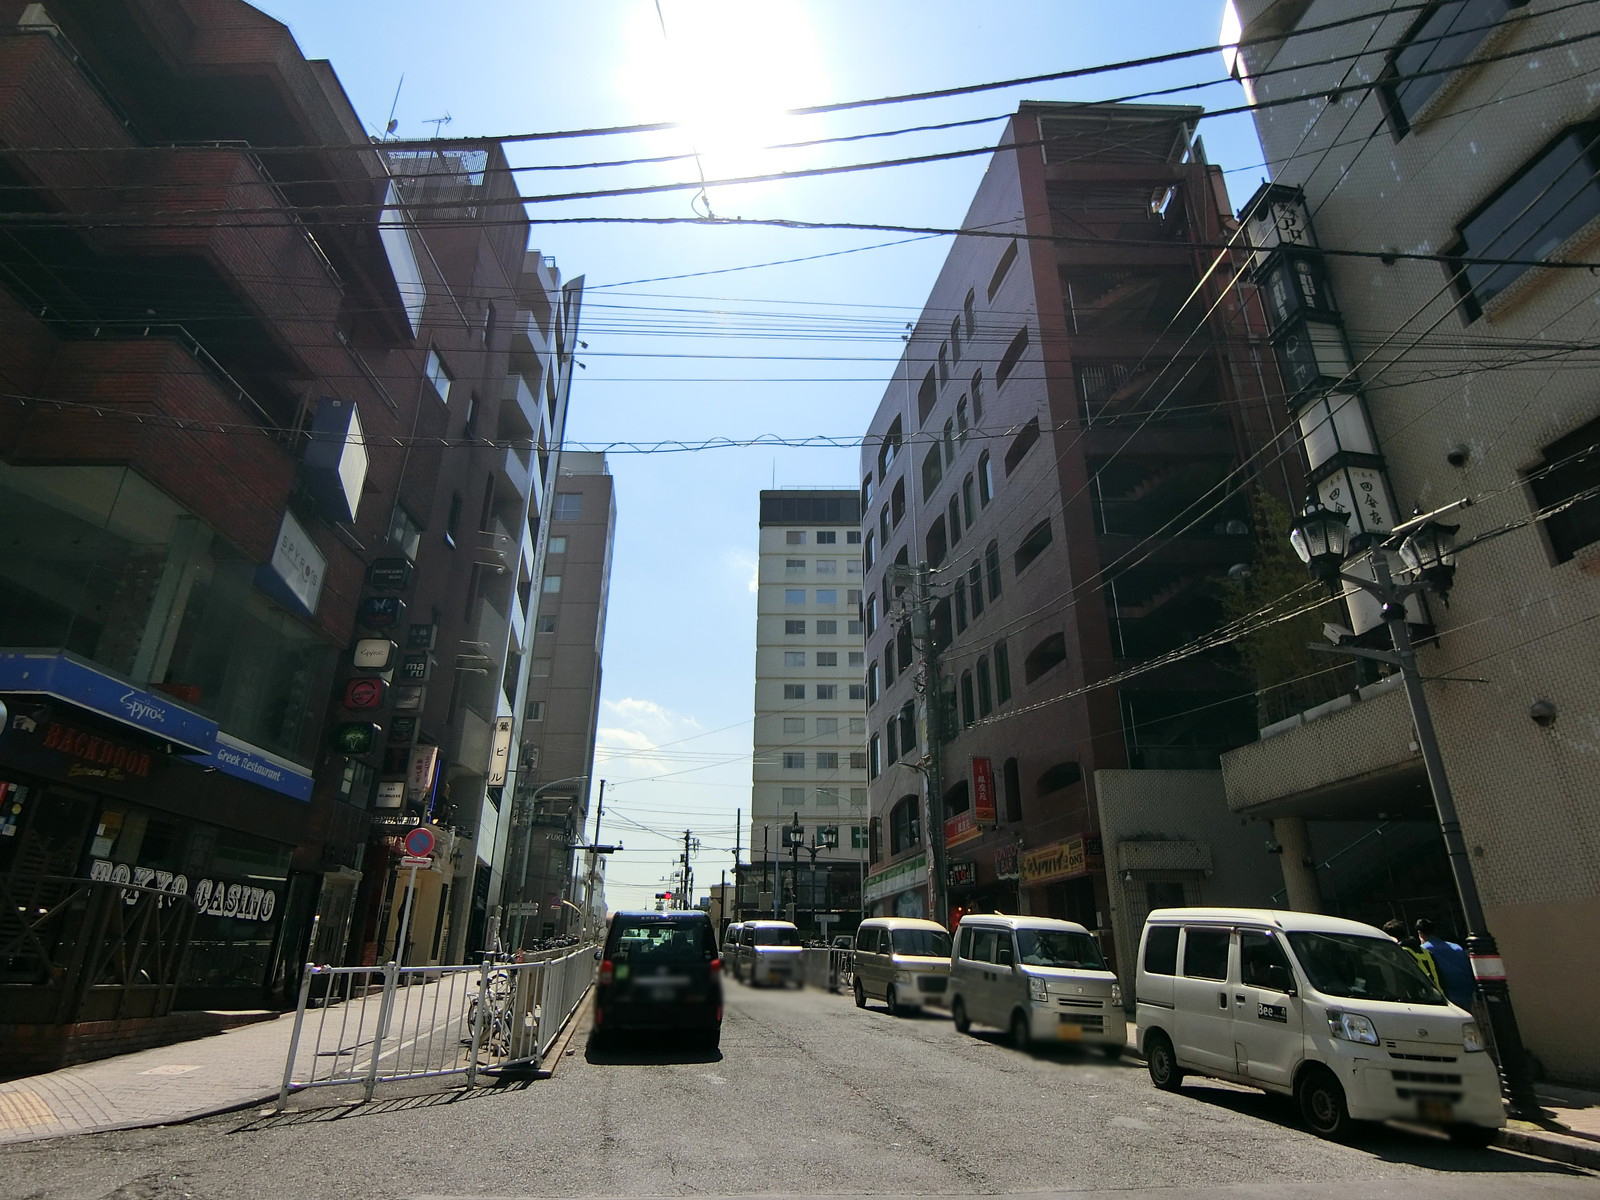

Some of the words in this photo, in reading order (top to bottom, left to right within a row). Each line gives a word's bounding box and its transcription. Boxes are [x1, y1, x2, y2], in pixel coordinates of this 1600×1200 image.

[217, 748, 240, 767] Greek
[242, 757, 281, 782] Restaurant
[194, 878, 276, 922] CASINO
[1258, 1003, 1274, 1017] Bee
